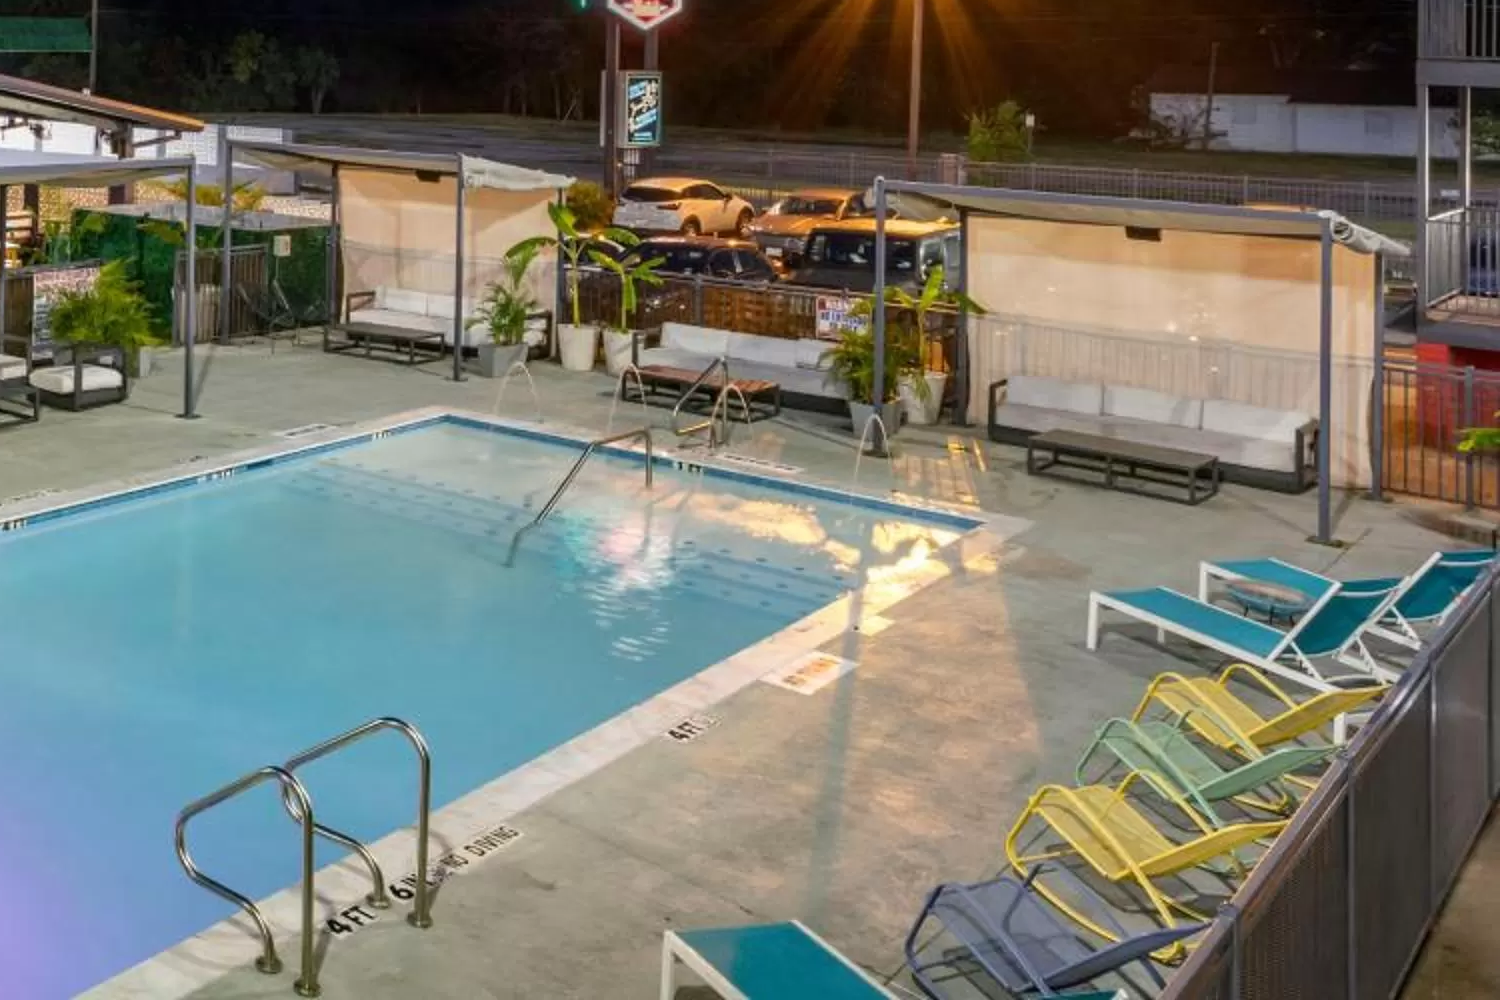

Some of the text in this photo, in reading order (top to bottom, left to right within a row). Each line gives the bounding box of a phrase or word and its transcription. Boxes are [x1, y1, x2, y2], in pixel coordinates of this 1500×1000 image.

[463, 825, 520, 857] DIVING
[326, 916, 353, 935] 4
[340, 905, 375, 927] FT
[389, 883, 415, 900] 6
